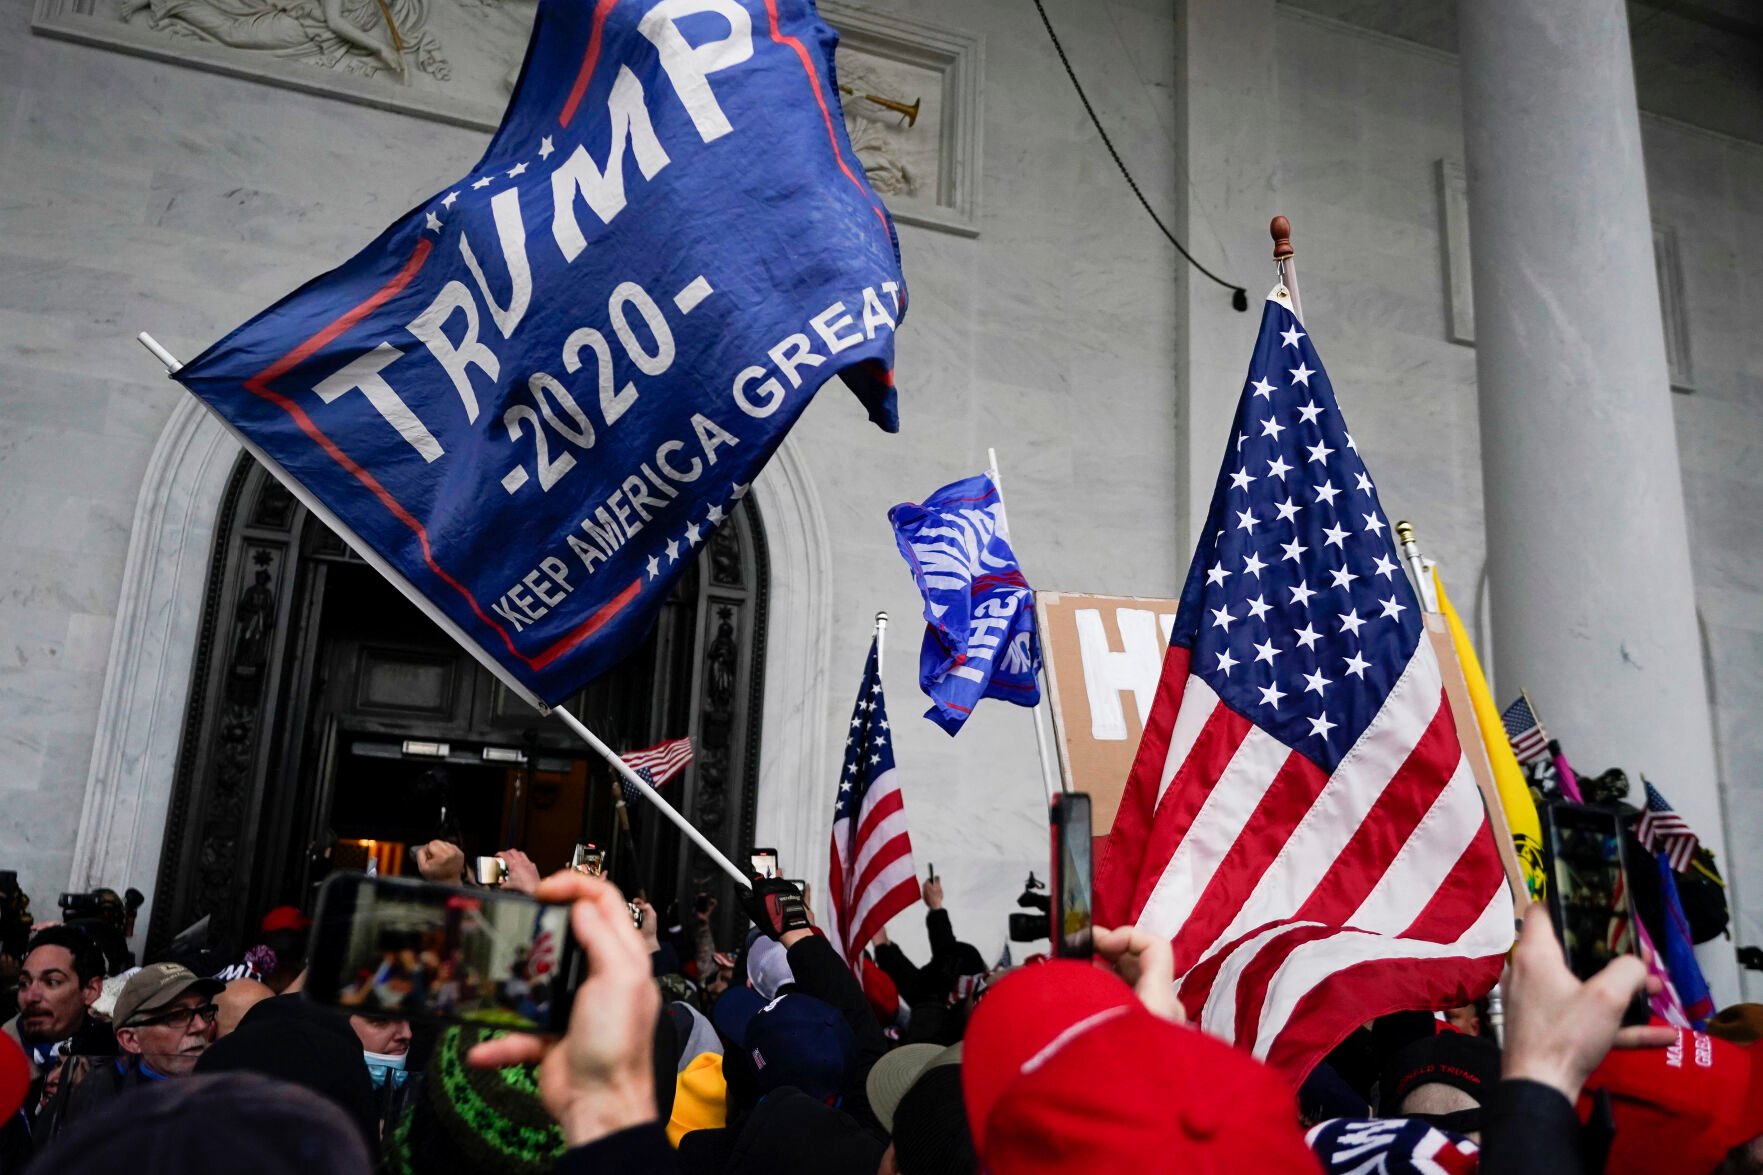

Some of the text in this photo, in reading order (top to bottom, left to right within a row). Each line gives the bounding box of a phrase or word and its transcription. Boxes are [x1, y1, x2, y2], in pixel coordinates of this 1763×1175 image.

[311, 0, 755, 464] TRUMP
[491, 280, 899, 633] KEEP AMERICA GREAT
[1440, 1063, 1481, 1084] TRUMP
